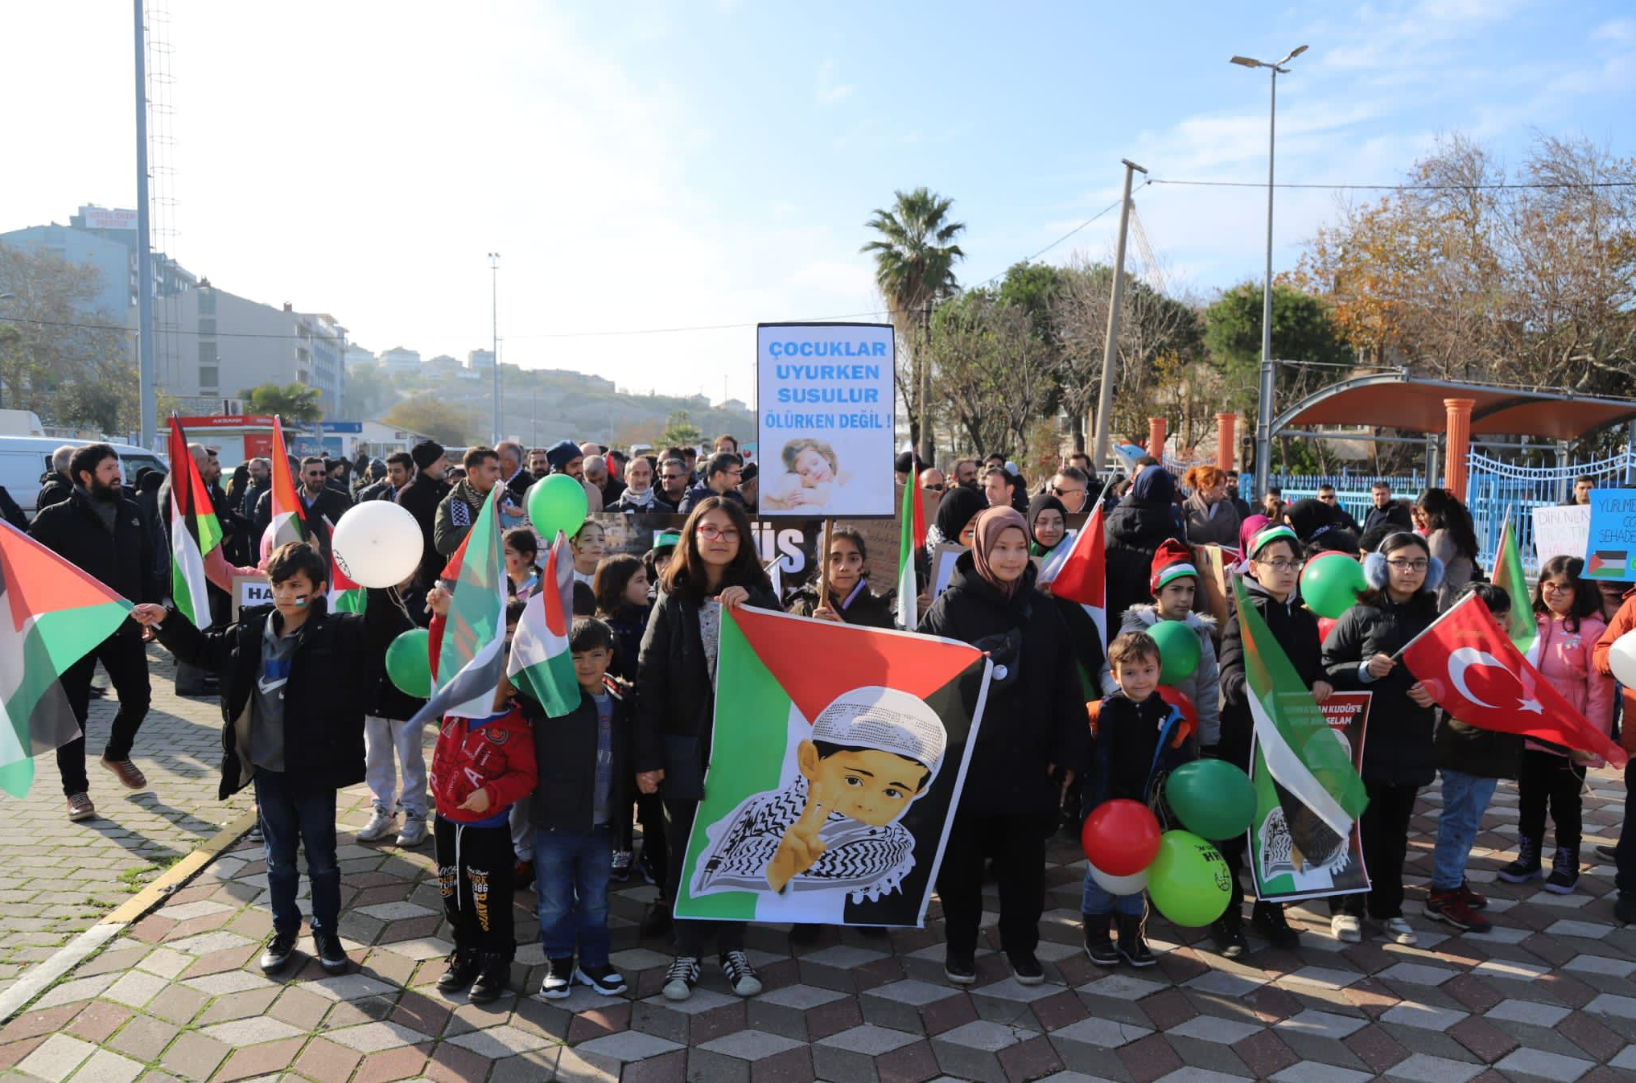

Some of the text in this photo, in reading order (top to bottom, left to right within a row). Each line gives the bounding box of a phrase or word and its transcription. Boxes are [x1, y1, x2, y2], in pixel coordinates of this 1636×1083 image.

[769, 341, 887, 360] ÇOCUKLAR
[776, 364, 880, 380] UYURKEN
[777, 387, 879, 403] SUSULUR
[765, 409, 835, 429] ÖLÜRKEN
[248, 587, 274, 600] HA
[1326, 716, 1352, 725] SELAM
